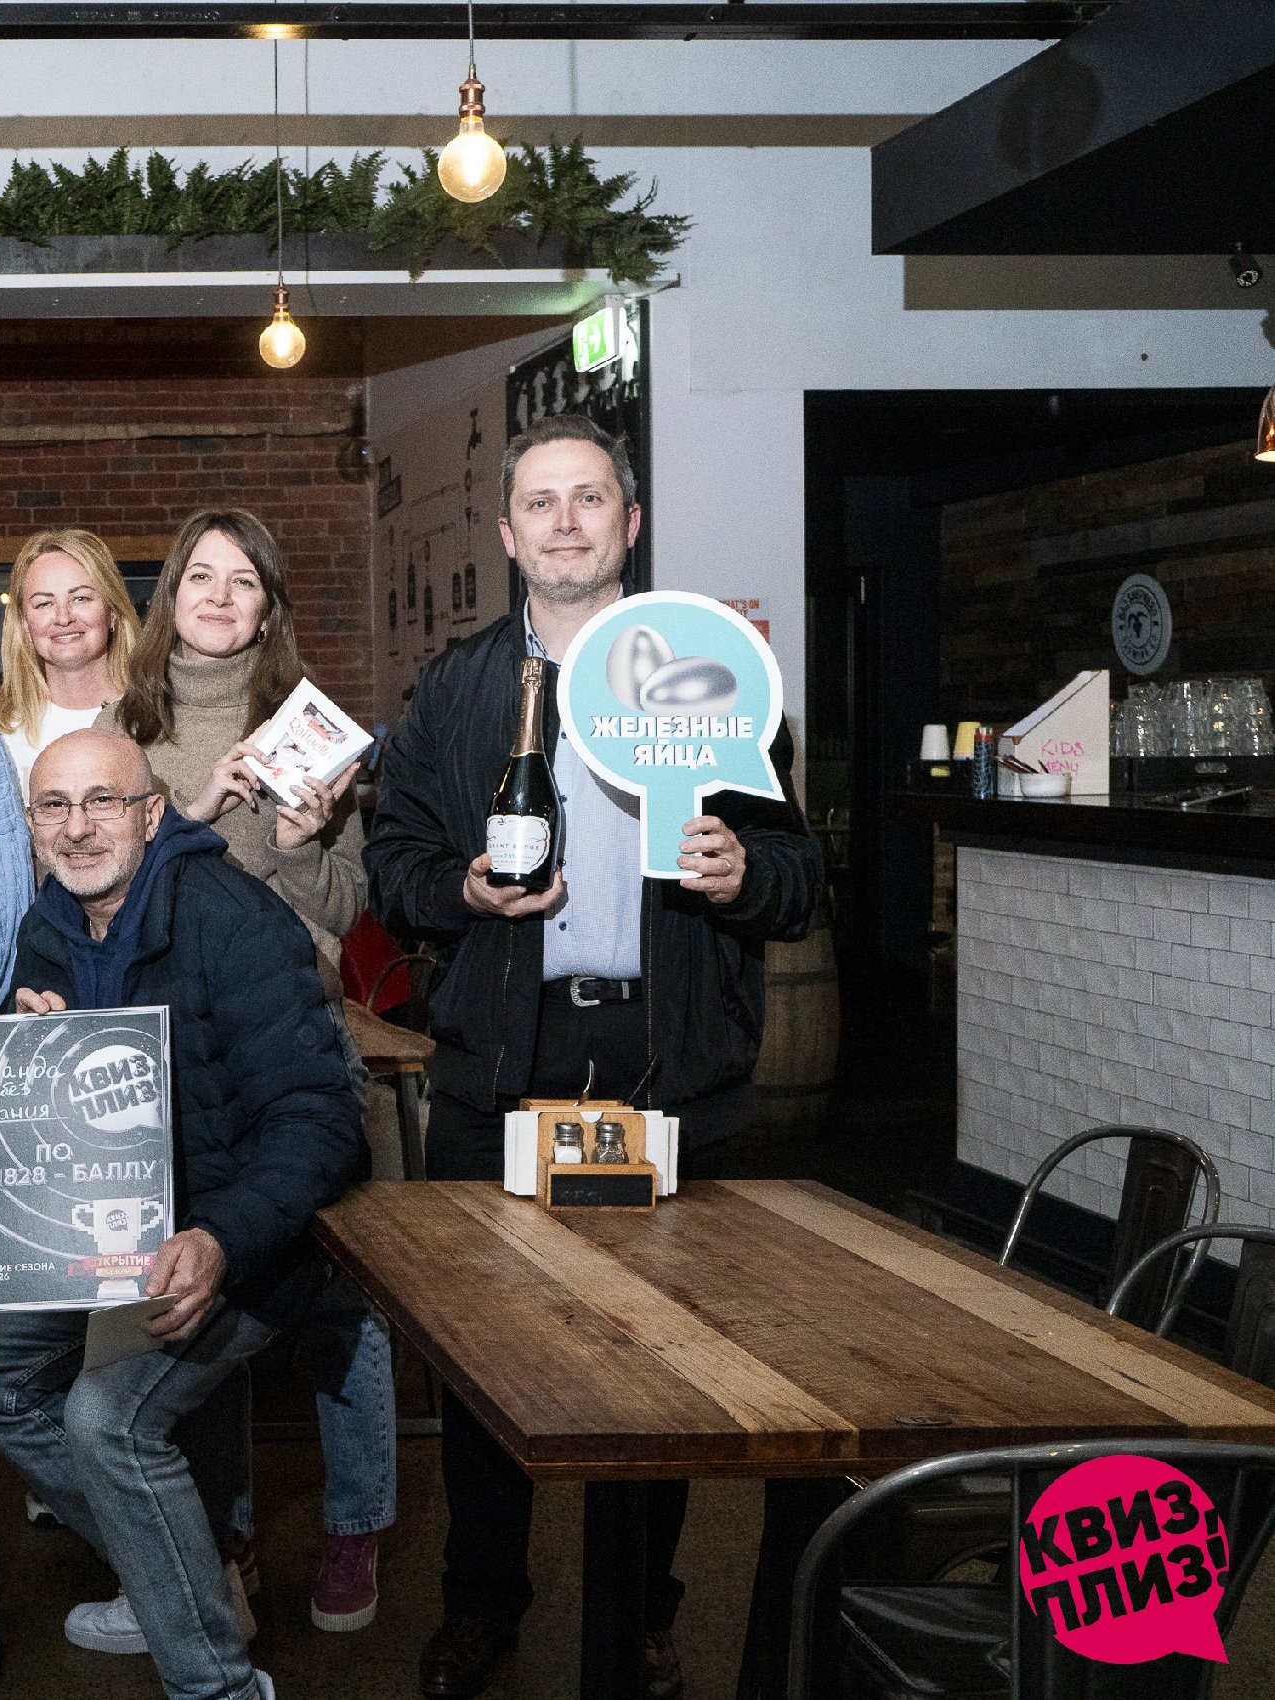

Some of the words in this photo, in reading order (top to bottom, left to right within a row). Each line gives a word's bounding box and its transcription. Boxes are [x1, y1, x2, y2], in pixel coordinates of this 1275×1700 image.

[590, 716, 754, 739] ЖЕЛЕЗНЫЕ
[634, 739, 718, 769] ЯЙЦА
[0, 1082, 31, 1096] без
[36, 1143, 74, 1163] ПО
[72, 1160, 157, 1183] БАЛЛУ
[14, 1261, 55, 1271] СЕЗОНА
